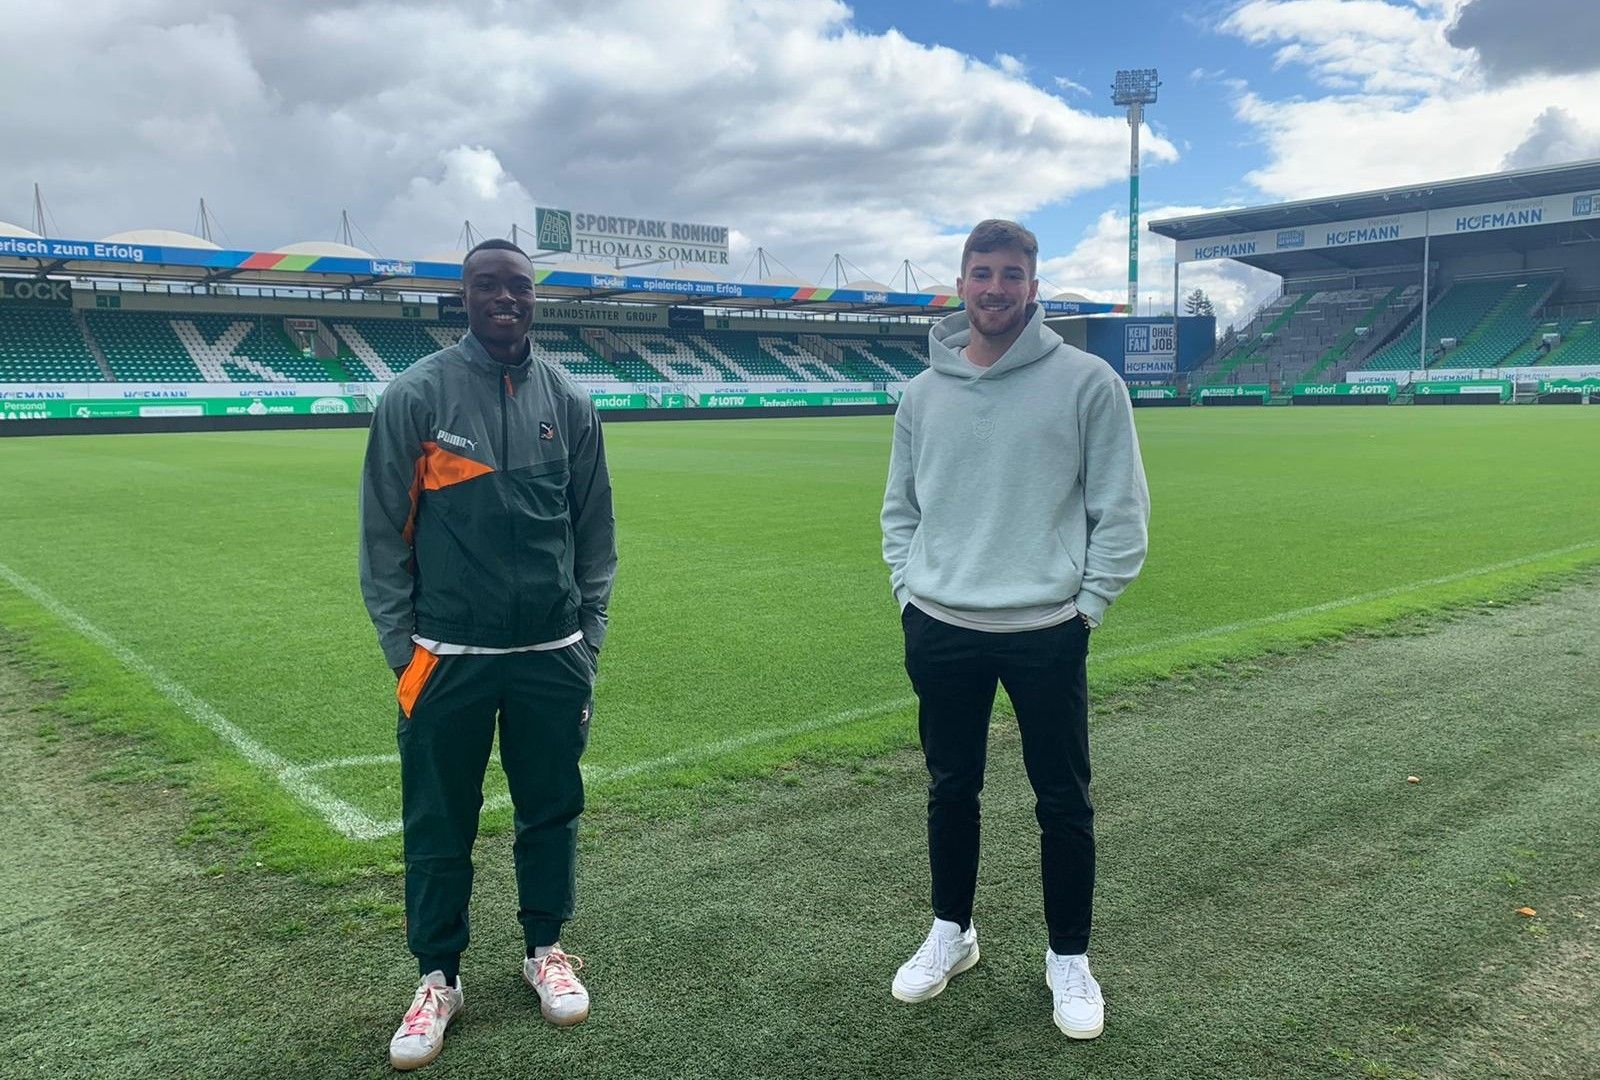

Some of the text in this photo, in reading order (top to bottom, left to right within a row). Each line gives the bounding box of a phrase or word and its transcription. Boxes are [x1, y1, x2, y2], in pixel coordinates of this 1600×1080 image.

[1456, 208, 1542, 231] HOFMANN
[575, 213, 728, 244] SPORTPARK RONHOF
[1327, 225, 1399, 245] HOFMANN
[53, 243, 89, 256] zum
[94, 244, 144, 262] Erfolg
[576, 239, 728, 265] THOMAS SOMMER
[1195, 242, 1255, 259] HOFMANN
[644, 280, 693, 292] spielerisch
[695, 284, 714, 293] zum
[716, 284, 742, 296] Erfolg
[542, 307, 619, 321] BRANDSTÄTTER
[626, 311, 657, 322] GROUP
[1128, 327, 1173, 338] KEIN OHNE
[1128, 338, 1173, 351] FAN JOB
[1126, 362, 1173, 372] HOFMANN
[1305, 384, 1389, 393] endori LOTTO
[4, 402, 46, 410] Personal
[595, 395, 631, 407] endori
[719, 396, 746, 406] LOTTO
[437, 430, 467, 448] PUMA
